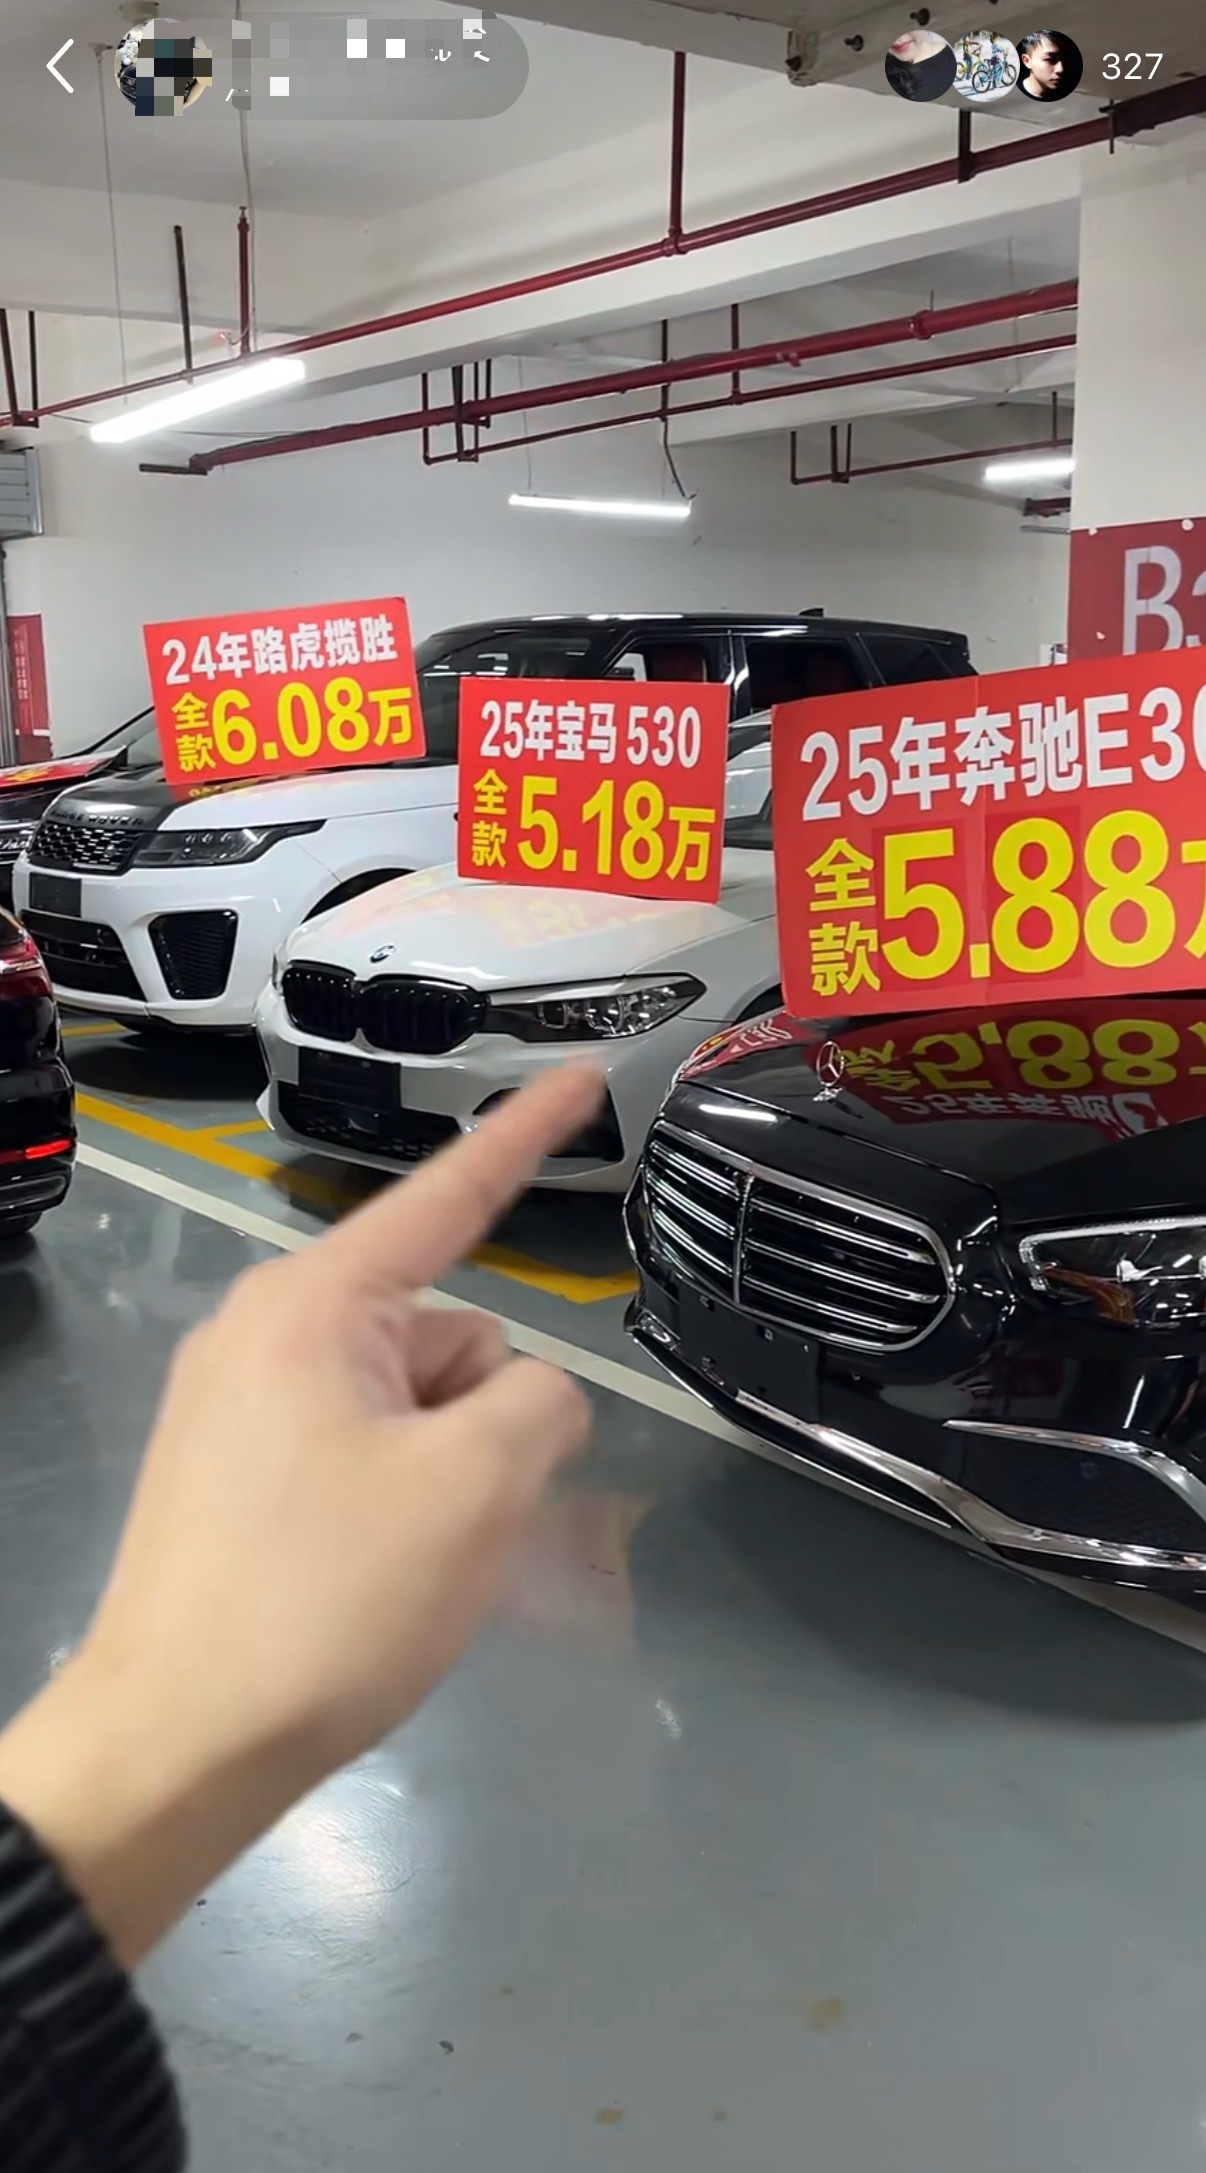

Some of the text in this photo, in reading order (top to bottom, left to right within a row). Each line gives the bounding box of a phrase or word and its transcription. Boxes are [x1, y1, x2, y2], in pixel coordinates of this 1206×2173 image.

[161, 614, 399, 685] 24年路虎揽胜
[1122, 545, 1206, 656] B
[171, 691, 217, 772] 全款
[212, 676, 413, 765] 6.08万
[800, 684, 1206, 821] 25年奔驰E3
[471, 769, 509, 868] 全款
[517, 774, 716, 882] 5.18万
[806, 837, 881, 997] 全款
[880, 809, 1206, 980] 5.88
